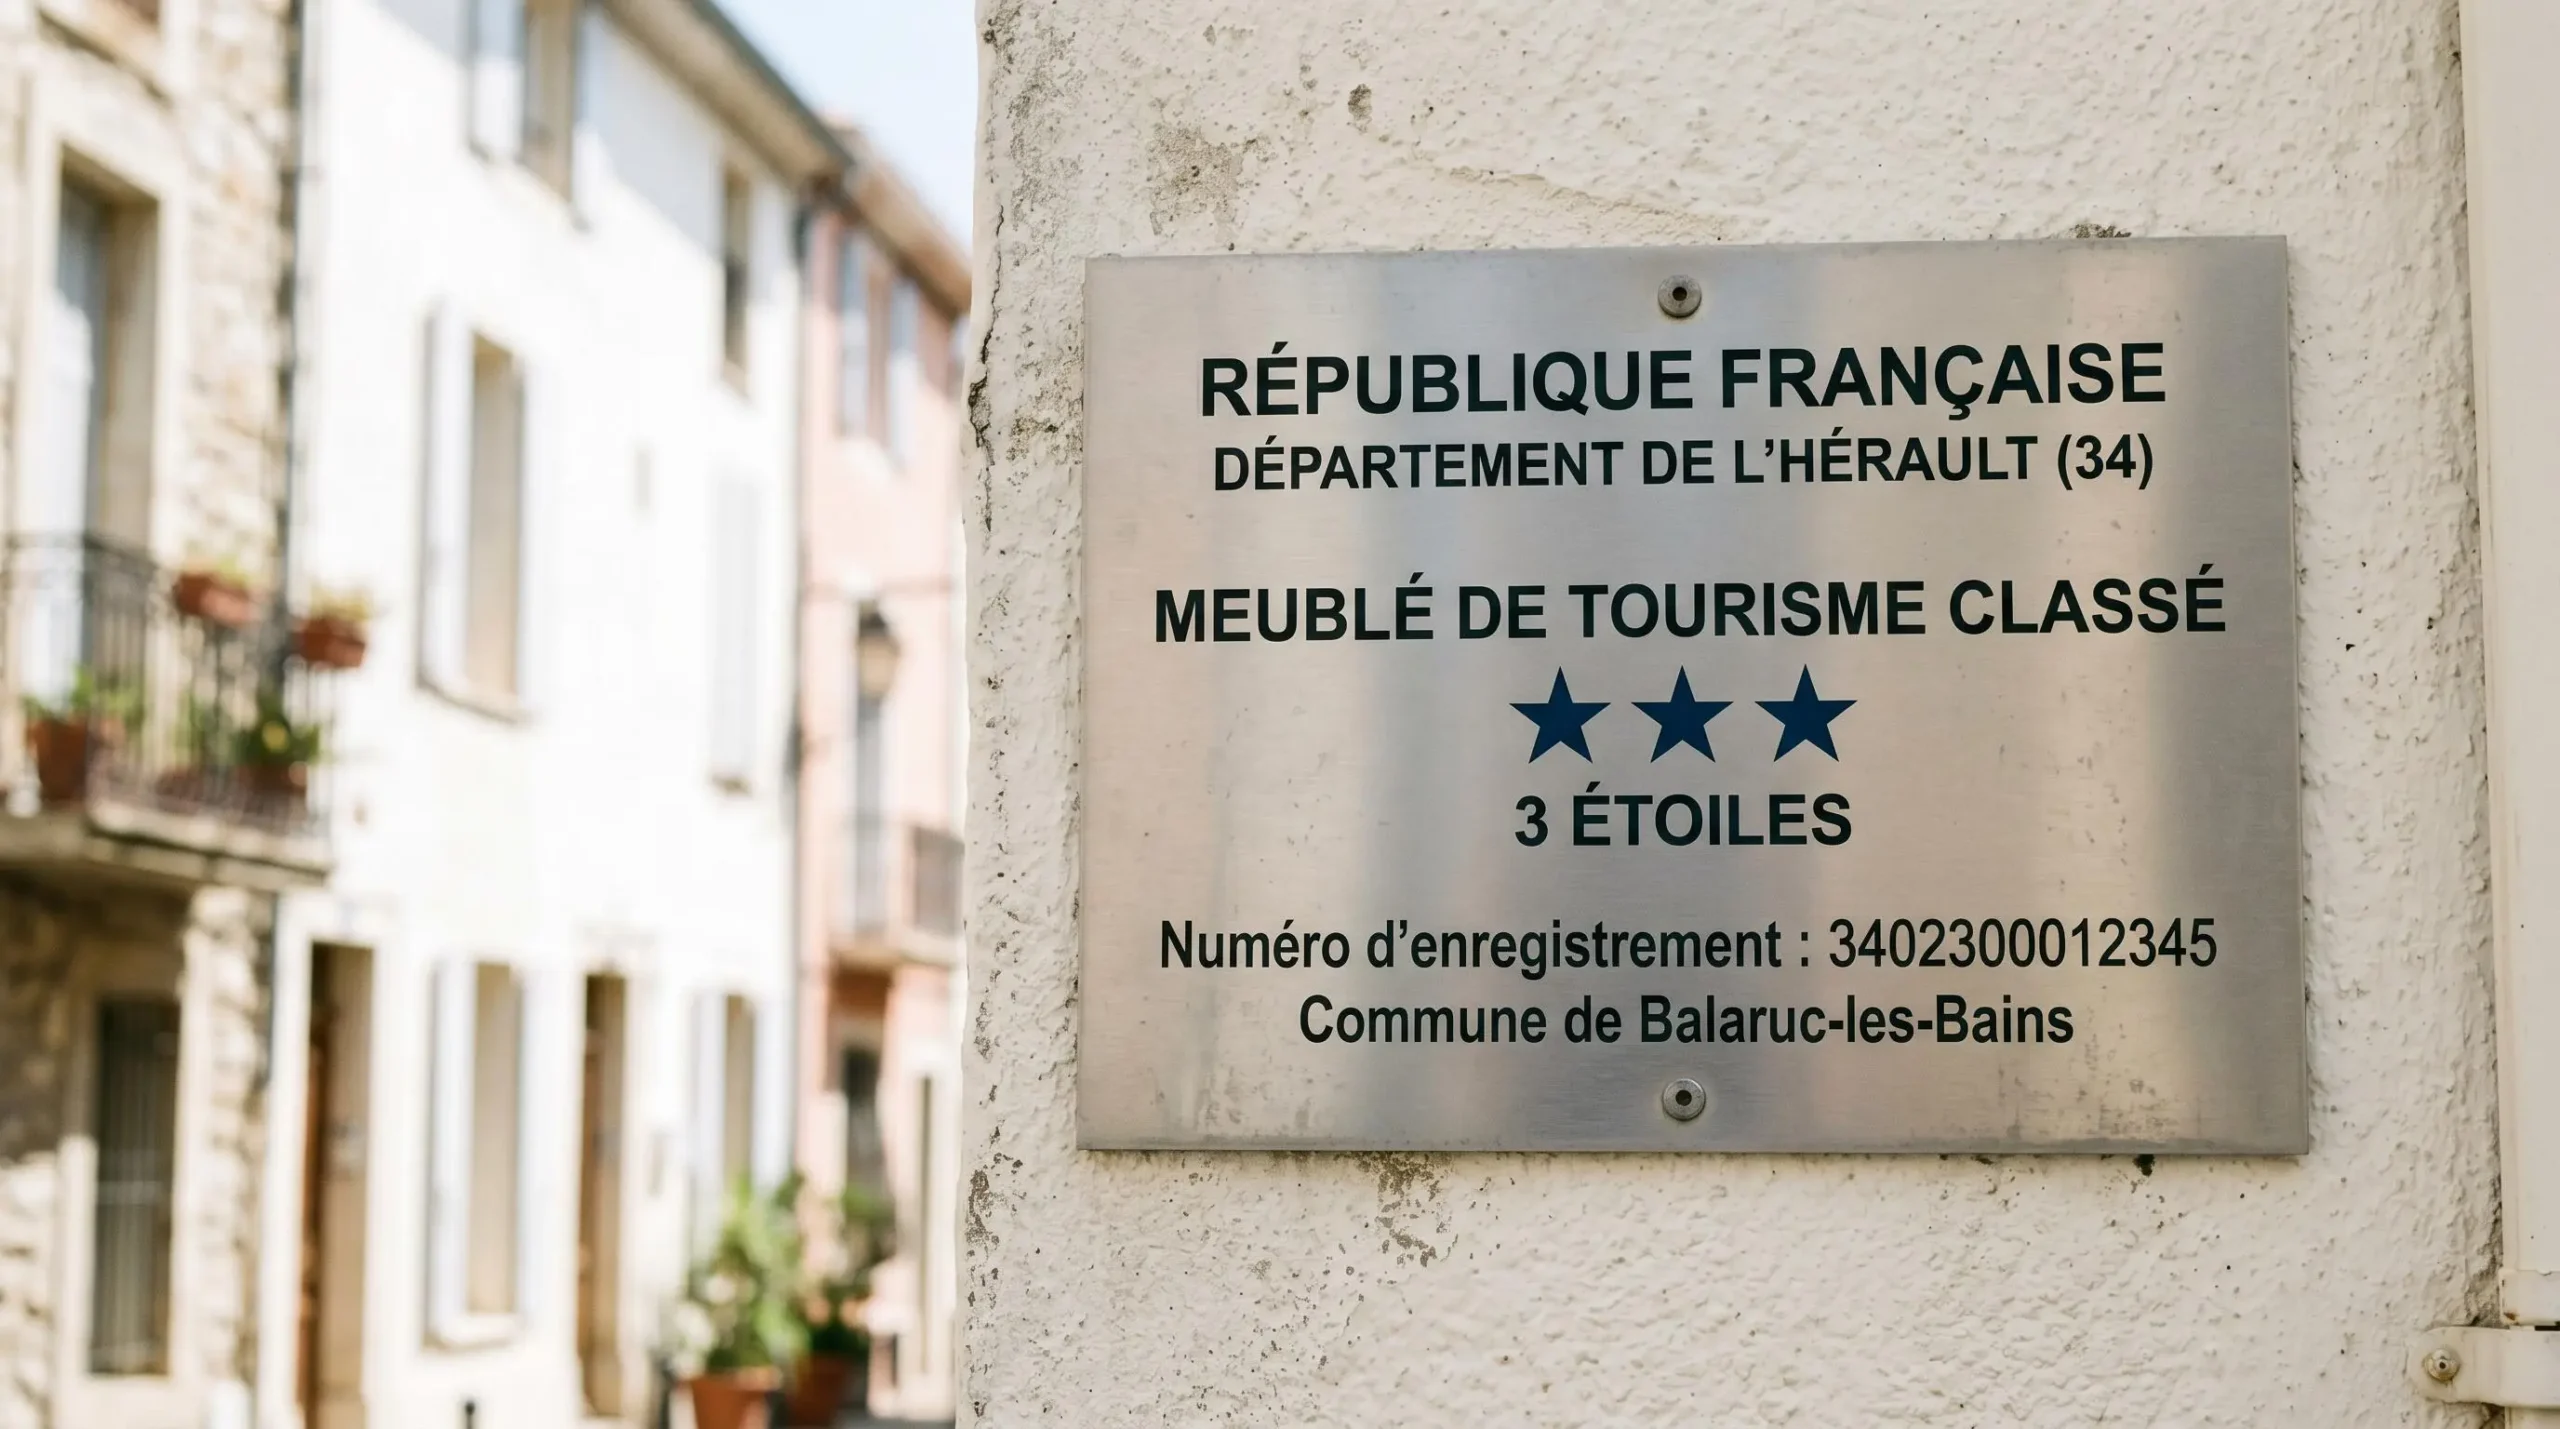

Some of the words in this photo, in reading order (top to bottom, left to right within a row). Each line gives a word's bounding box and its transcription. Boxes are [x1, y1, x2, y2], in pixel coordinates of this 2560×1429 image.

[1202, 341, 1693, 416] RÉPUBLIQUE
[1721, 343, 2166, 420] FRANÇAISE
[1214, 435, 1625, 491] DÉPARTEMENT
[1643, 441, 1716, 486] DE
[1734, 426, 2039, 484] L’HÉRAULT
[2058, 434, 2155, 492] (34)
[1156, 572, 1435, 644] MEUBLÉ
[1459, 586, 1548, 641] DE
[1568, 581, 1927, 640] TOURISME
[1950, 563, 2228, 637] CLASSÉ
[1515, 795, 1550, 849] 3
[1573, 781, 1853, 849] ÉTOILES
[1162, 920, 1352, 970] Numéro
[1367, 920, 1783, 981] d’enregistrement
[1801, 932, 1810, 969] :
[1830, 918, 2219, 970] 3402300012345
[1300, 995, 1548, 1045] Commune
[1564, 995, 1623, 1044] de
[1640, 994, 2075, 1045] Balaruc-les-Bains
